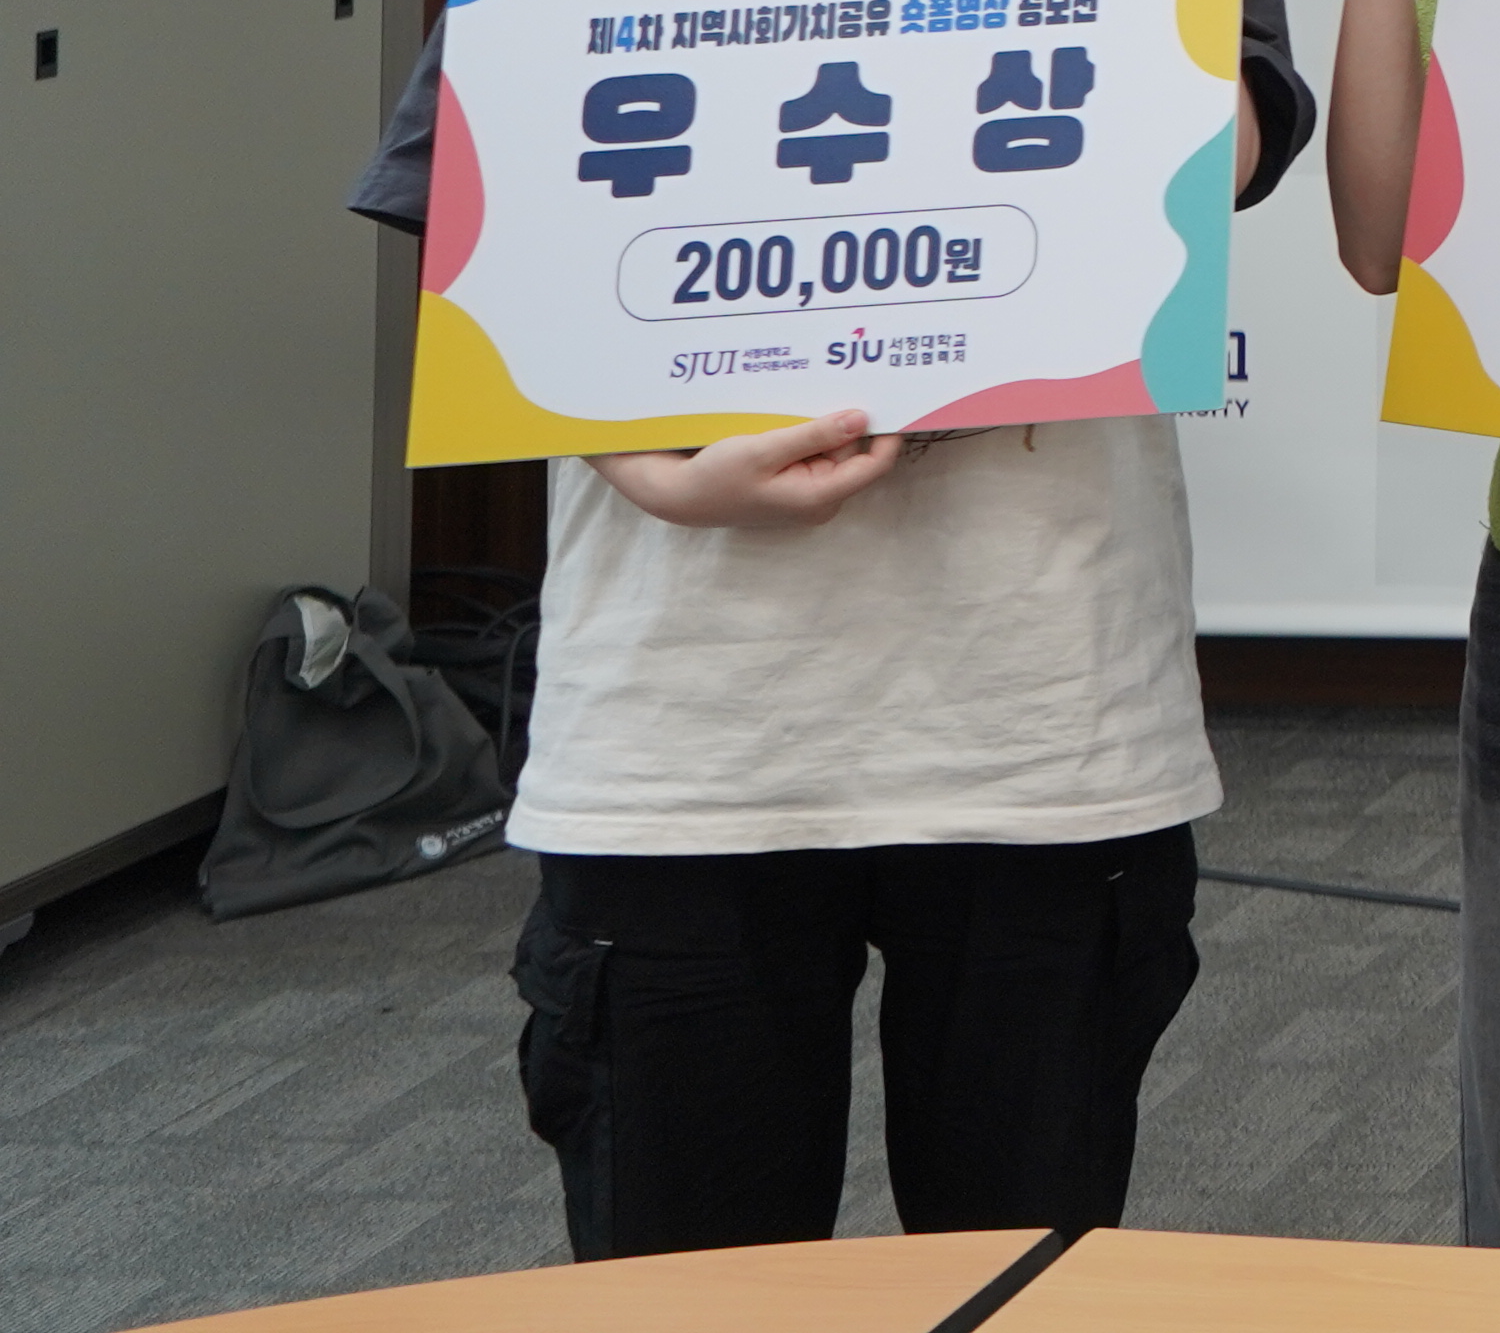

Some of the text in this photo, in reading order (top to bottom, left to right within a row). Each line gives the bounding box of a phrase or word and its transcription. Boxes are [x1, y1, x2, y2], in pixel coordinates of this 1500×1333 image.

[587, 14, 664, 55] 제4차
[671, 223, 982, 309] 200,000원
[889, 333, 967, 351] 서정대학교
[889, 348, 967, 368] 대외협력처
[669, 349, 737, 385] SJUI
